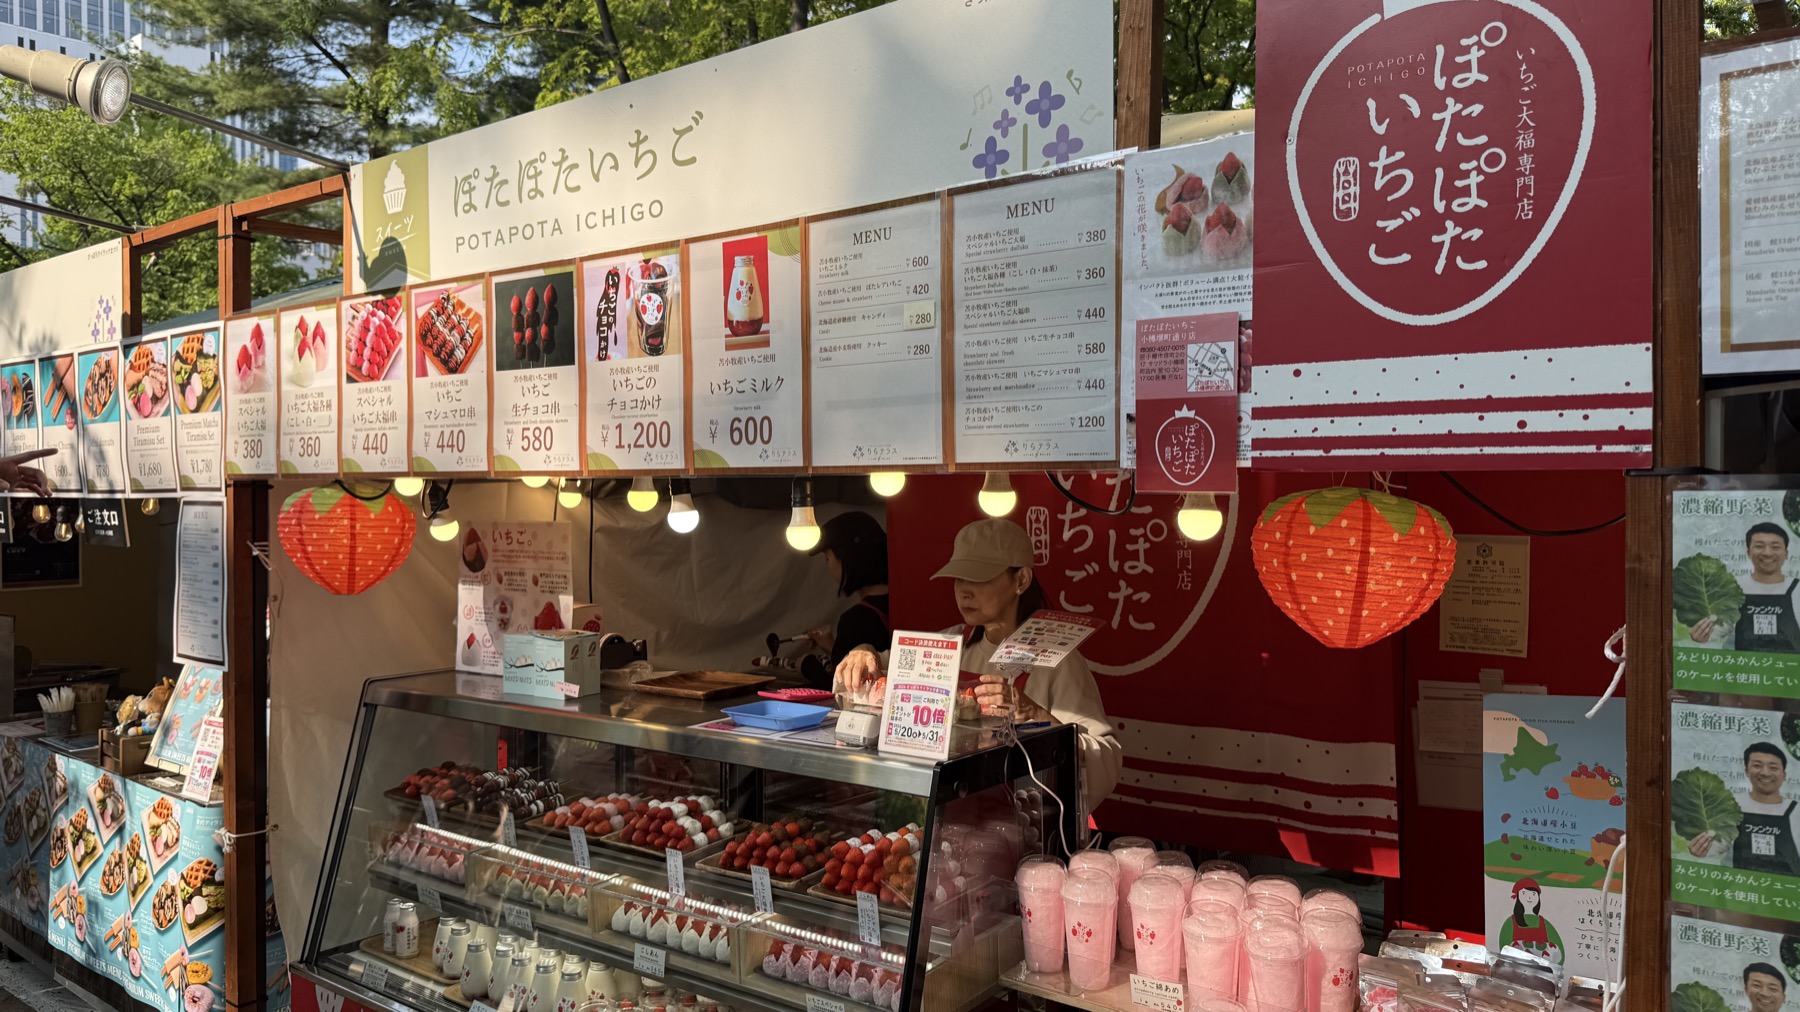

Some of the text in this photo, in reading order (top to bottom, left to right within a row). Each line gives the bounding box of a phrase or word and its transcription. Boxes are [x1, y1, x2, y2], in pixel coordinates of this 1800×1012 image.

[1347, 52, 1426, 75] POTAPOTA
[1347, 66, 1426, 89] ICHIGO
[1514, 46, 1537, 221] いちご大福専門店
[1431, 20, 1507, 276] ぽたぽた
[453, 110, 704, 218] ぽたぽたいちご
[1366, 92, 1421, 267] いちご
[1006, 198, 1056, 219] MENU
[376, 214, 414, 240] スイーツ
[454, 198, 665, 253] POTAPOTA ICHIGO
[852, 226, 893, 246] MENU
[1085, 229, 1106, 243] 380
[912, 255, 929, 268] 600
[1084, 266, 1106, 280] 360
[912, 283, 929, 296] 420
[915, 312, 932, 325] 280
[1084, 306, 1106, 320] 440
[913, 344, 930, 356] 280
[1084, 341, 1106, 355] 580
[609, 364, 660, 375] 苫小牧産いちご使用
[718, 353, 776, 367] 苫小牧産いちご使用
[521, 383, 550, 398] いちご
[612, 377, 657, 392] いちごの
[709, 375, 784, 396] いちごミルク
[1084, 378, 1105, 391] 440
[356, 395, 393, 408] スペシャル
[437, 389, 462, 403] いちご
[607, 394, 662, 412] チョコかけ
[424, 405, 476, 419] マシュマロ串
[512, 401, 560, 417] 生チョコ串
[729, 415, 773, 447] 600
[1077, 415, 1105, 428] 1200
[298, 436, 320, 458] 360
[363, 433, 388, 455] 440
[436, 429, 465, 454] 440
[521, 426, 554, 453] 580
[615, 420, 671, 454] 1,200
[243, 439, 263, 459] 380
[1171, 433, 1184, 473] いちご
[1184, 422, 1200, 476] ぽたぽた
[1680, 497, 1773, 516] 濃縮野菜
[1679, 711, 1771, 735] 濃縮野菜
[1675, 864, 1800, 889] みどりのみかんジュー
[1679, 924, 1769, 956] 濃縮野菜
